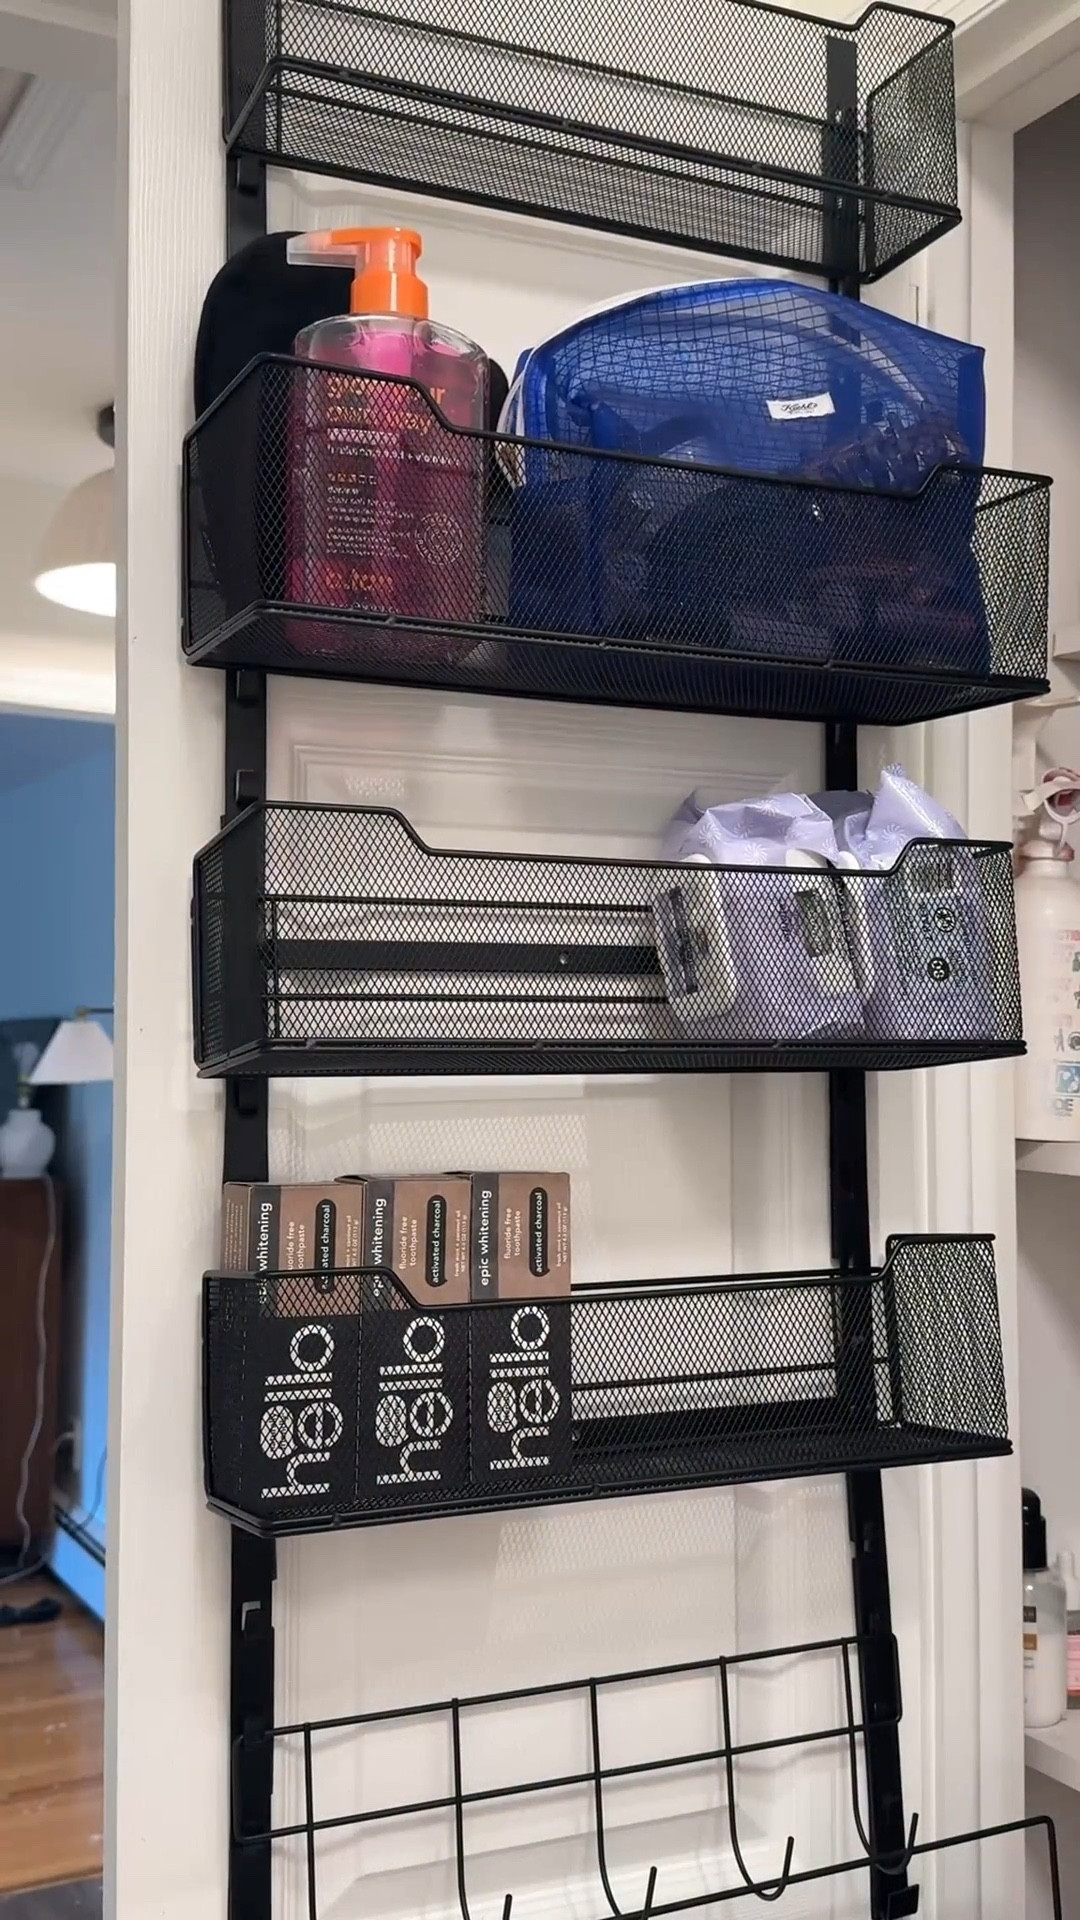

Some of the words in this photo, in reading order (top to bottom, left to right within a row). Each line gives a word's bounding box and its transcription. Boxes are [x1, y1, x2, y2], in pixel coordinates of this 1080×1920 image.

[286, 1221, 296, 1240] free
[320, 1204, 331, 1244] charcoal
[372, 1198, 387, 1265] whitening
[399, 1216, 408, 1234] free
[431, 1200, 441, 1239] charcoal
[478, 1190, 492, 1255] whitening
[504, 1207, 512, 1225] free
[534, 1192, 543, 1229] charcoal
[256, 1202, 273, 1271] whitening
[296, 1224, 306, 1270] oothpaste
[398, 1236, 407, 1270] fluoride
[409, 1219, 418, 1266] toothpaste
[503, 1227, 512, 1260] fluoride
[513, 1210, 522, 1256] toothpaste
[534, 1231, 543, 1273] activated
[431, 1241, 441, 1283] activated
[478, 1257, 491, 1287] epic
[376, 1316, 454, 1485] hello
[489, 1305, 560, 1470] hello
[261, 1325, 343, 1498] hello
